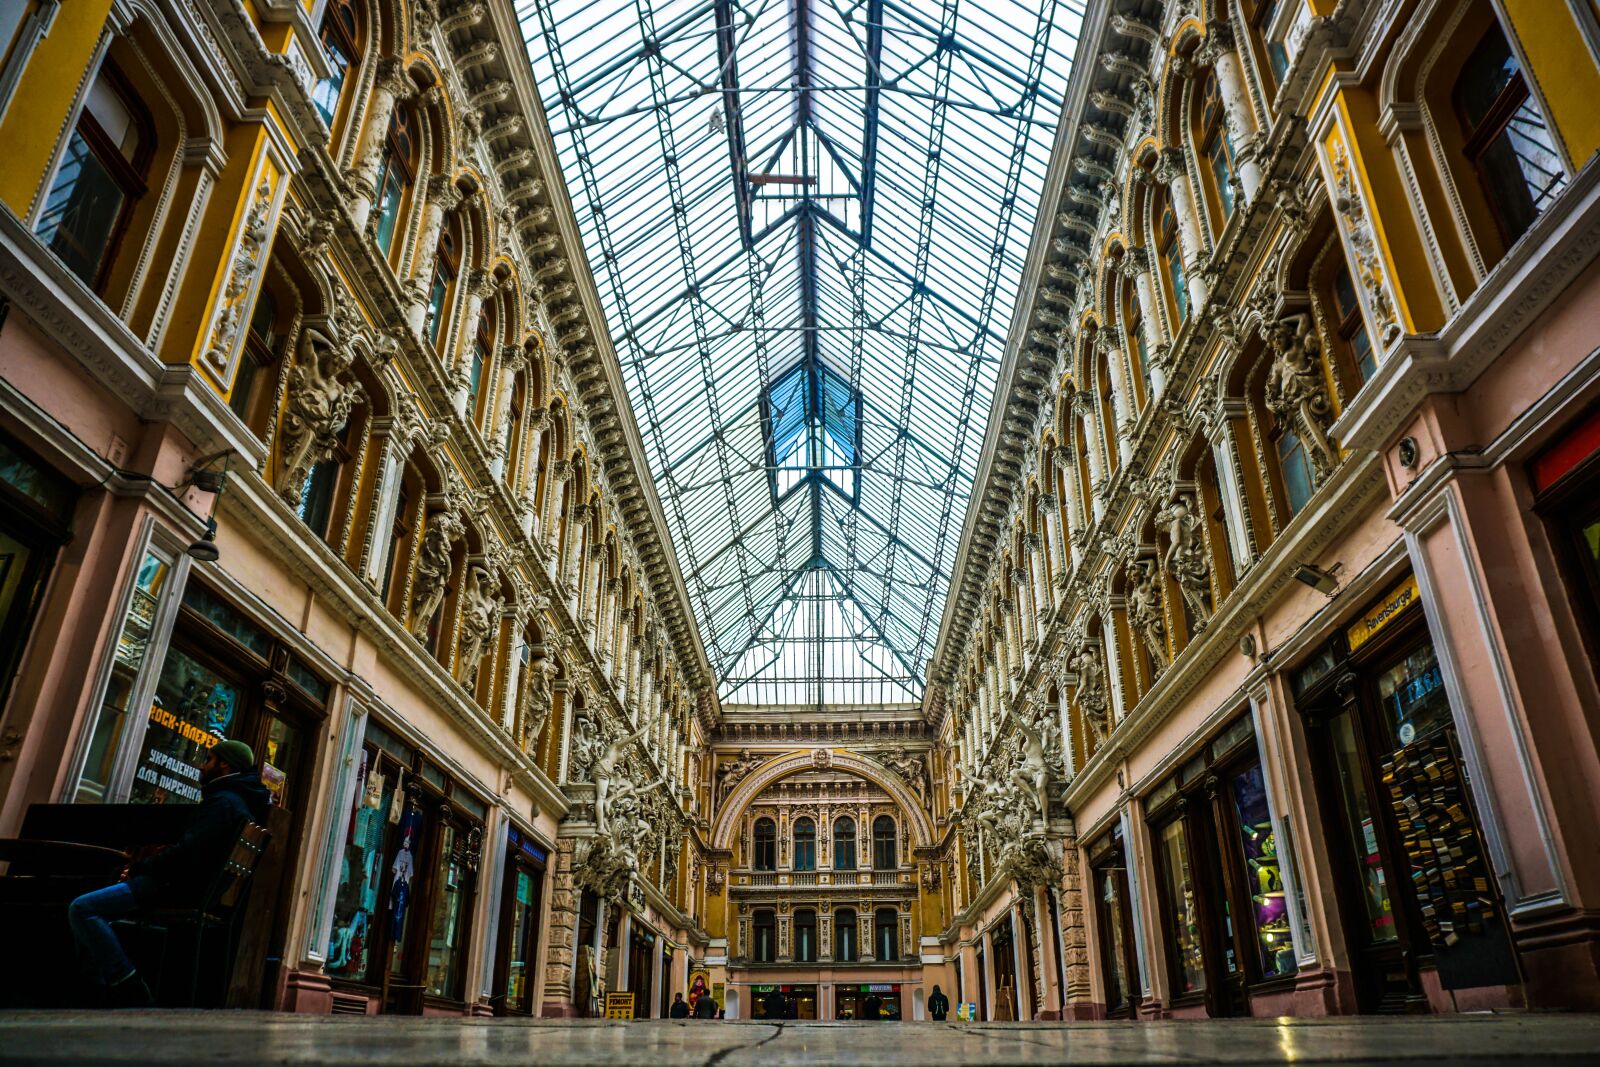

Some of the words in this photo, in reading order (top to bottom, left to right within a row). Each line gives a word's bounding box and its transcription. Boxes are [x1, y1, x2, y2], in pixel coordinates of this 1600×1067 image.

[149, 749, 201, 781] УКРАШЕНИЯ
[137, 766, 159, 784] ДЛЯ
[159, 774, 202, 802] ПИРСИНГА
